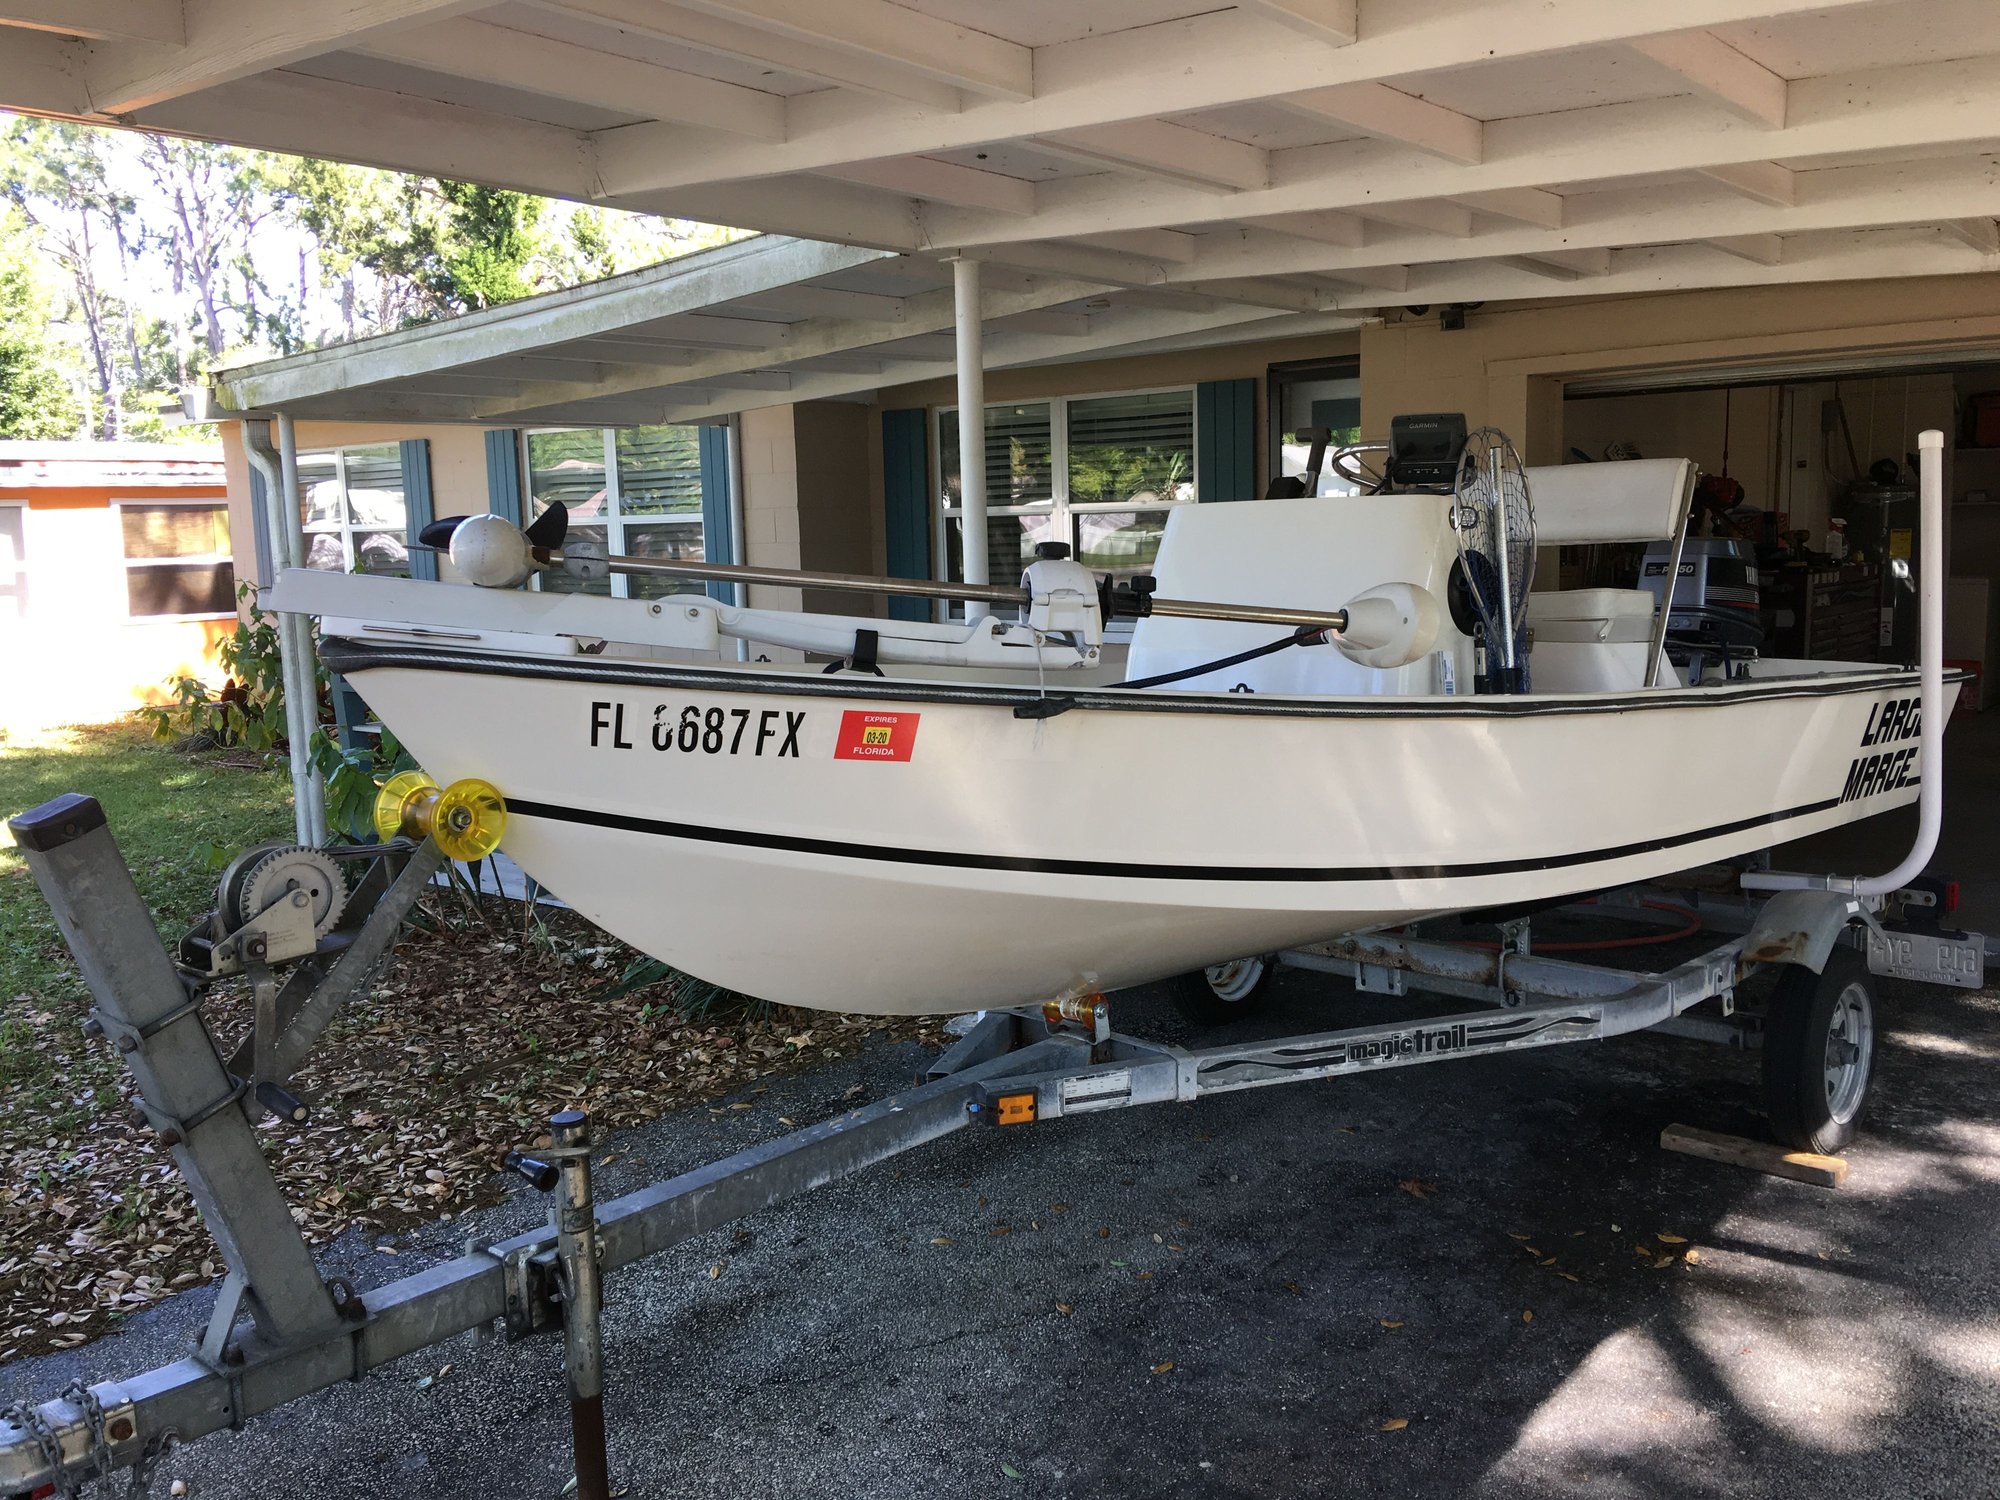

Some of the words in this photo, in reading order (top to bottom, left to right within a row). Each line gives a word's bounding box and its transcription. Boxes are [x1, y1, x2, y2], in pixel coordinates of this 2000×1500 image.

[590, 701, 633, 750] FL
[864, 715, 898, 724] EXPIRES
[1860, 697, 1921, 747] LARG
[853, 746, 895, 756] FLORIDA
[866, 731, 888, 744] 03-20
[1838, 747, 1919, 804] MARGE
